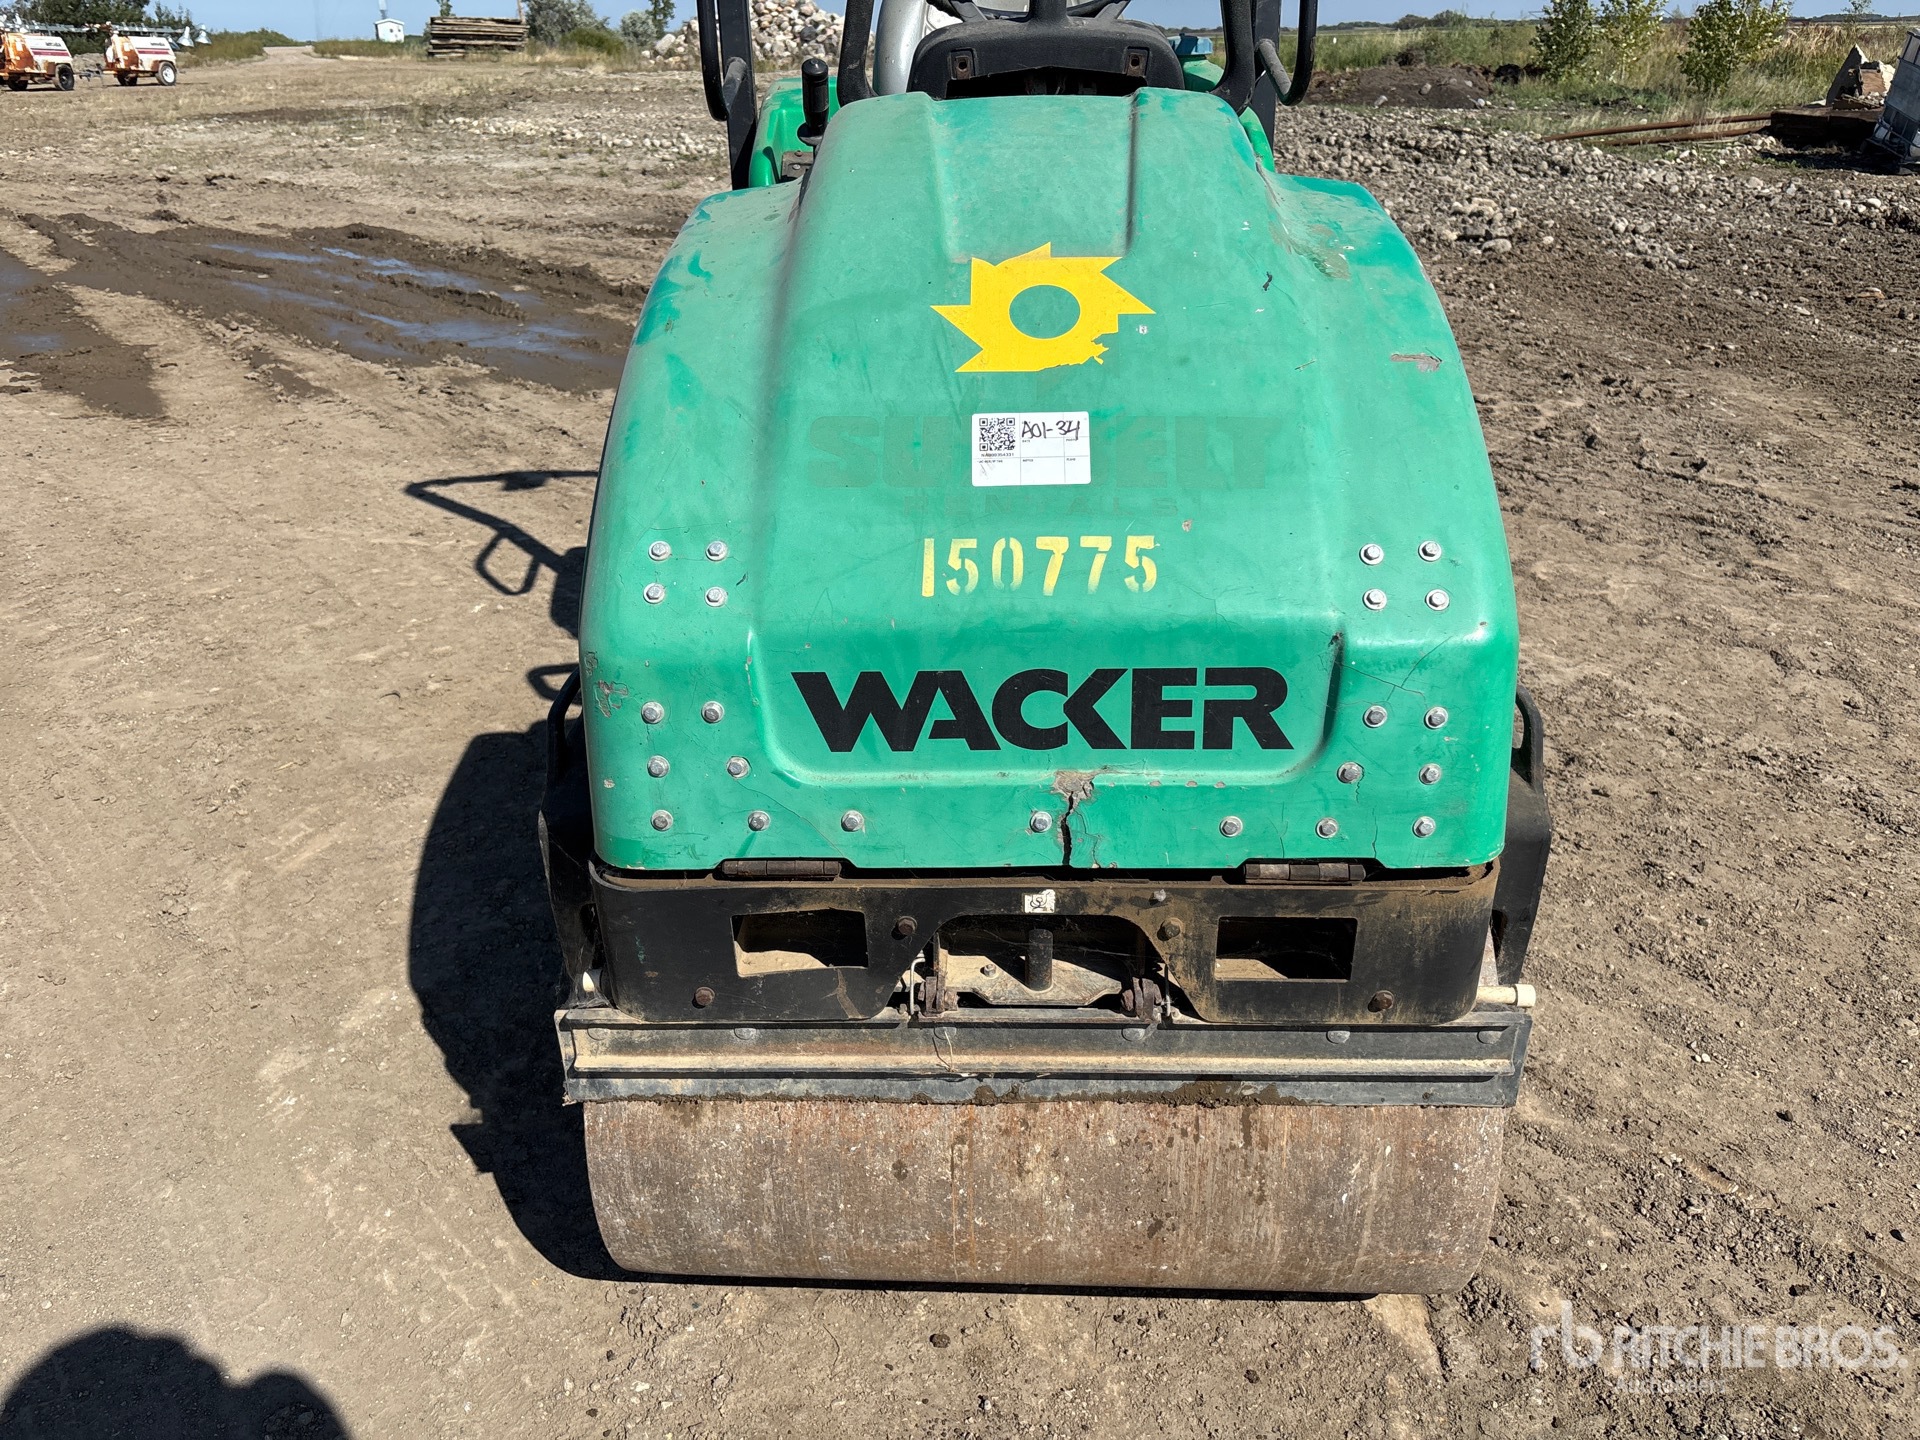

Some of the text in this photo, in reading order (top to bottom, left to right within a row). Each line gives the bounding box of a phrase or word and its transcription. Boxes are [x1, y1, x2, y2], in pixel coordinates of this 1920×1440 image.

[808, 415, 1282, 489] SUELT
[921, 535, 1158, 598] 150775
[790, 667, 1294, 753] WACKER
